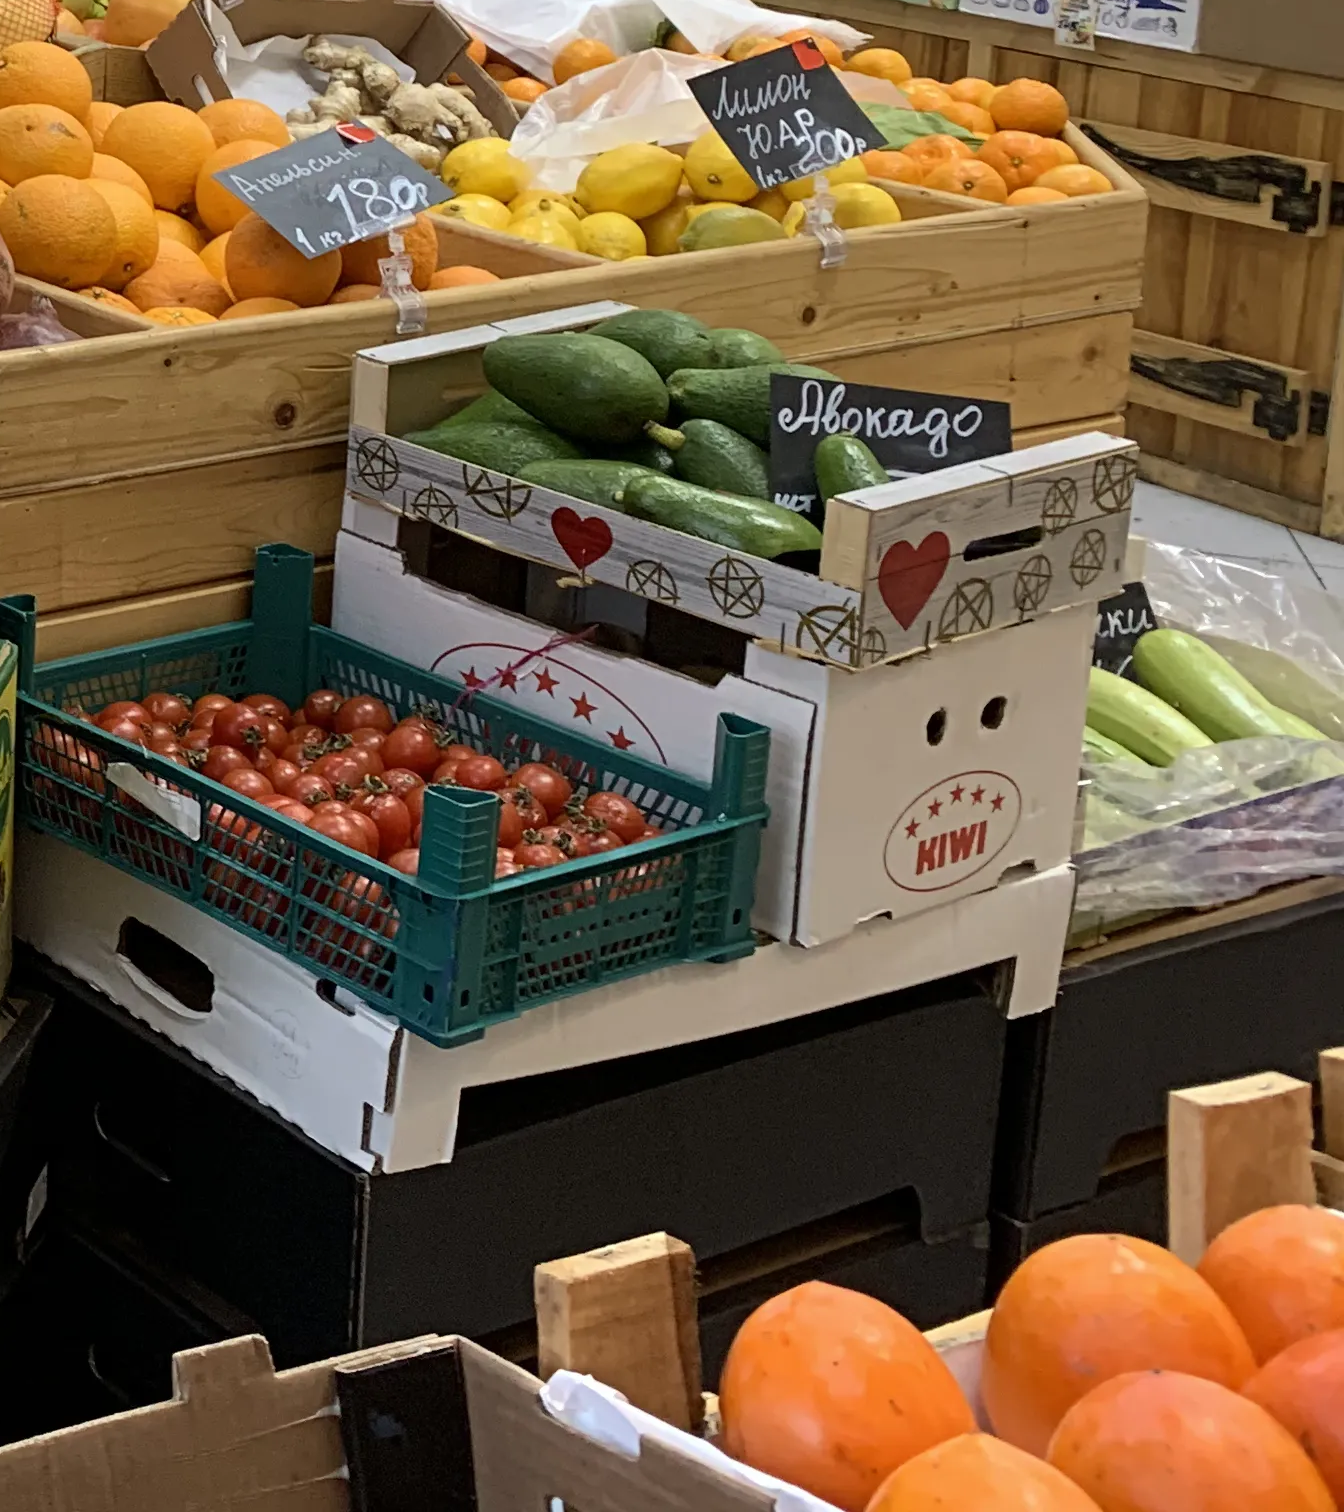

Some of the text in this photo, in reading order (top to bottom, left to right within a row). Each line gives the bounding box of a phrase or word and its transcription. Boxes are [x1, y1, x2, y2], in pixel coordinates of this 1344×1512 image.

[712, 72, 812, 121] Лимон
[777, 379, 983, 459] Авокадо
[915, 820, 988, 876] KIWI
